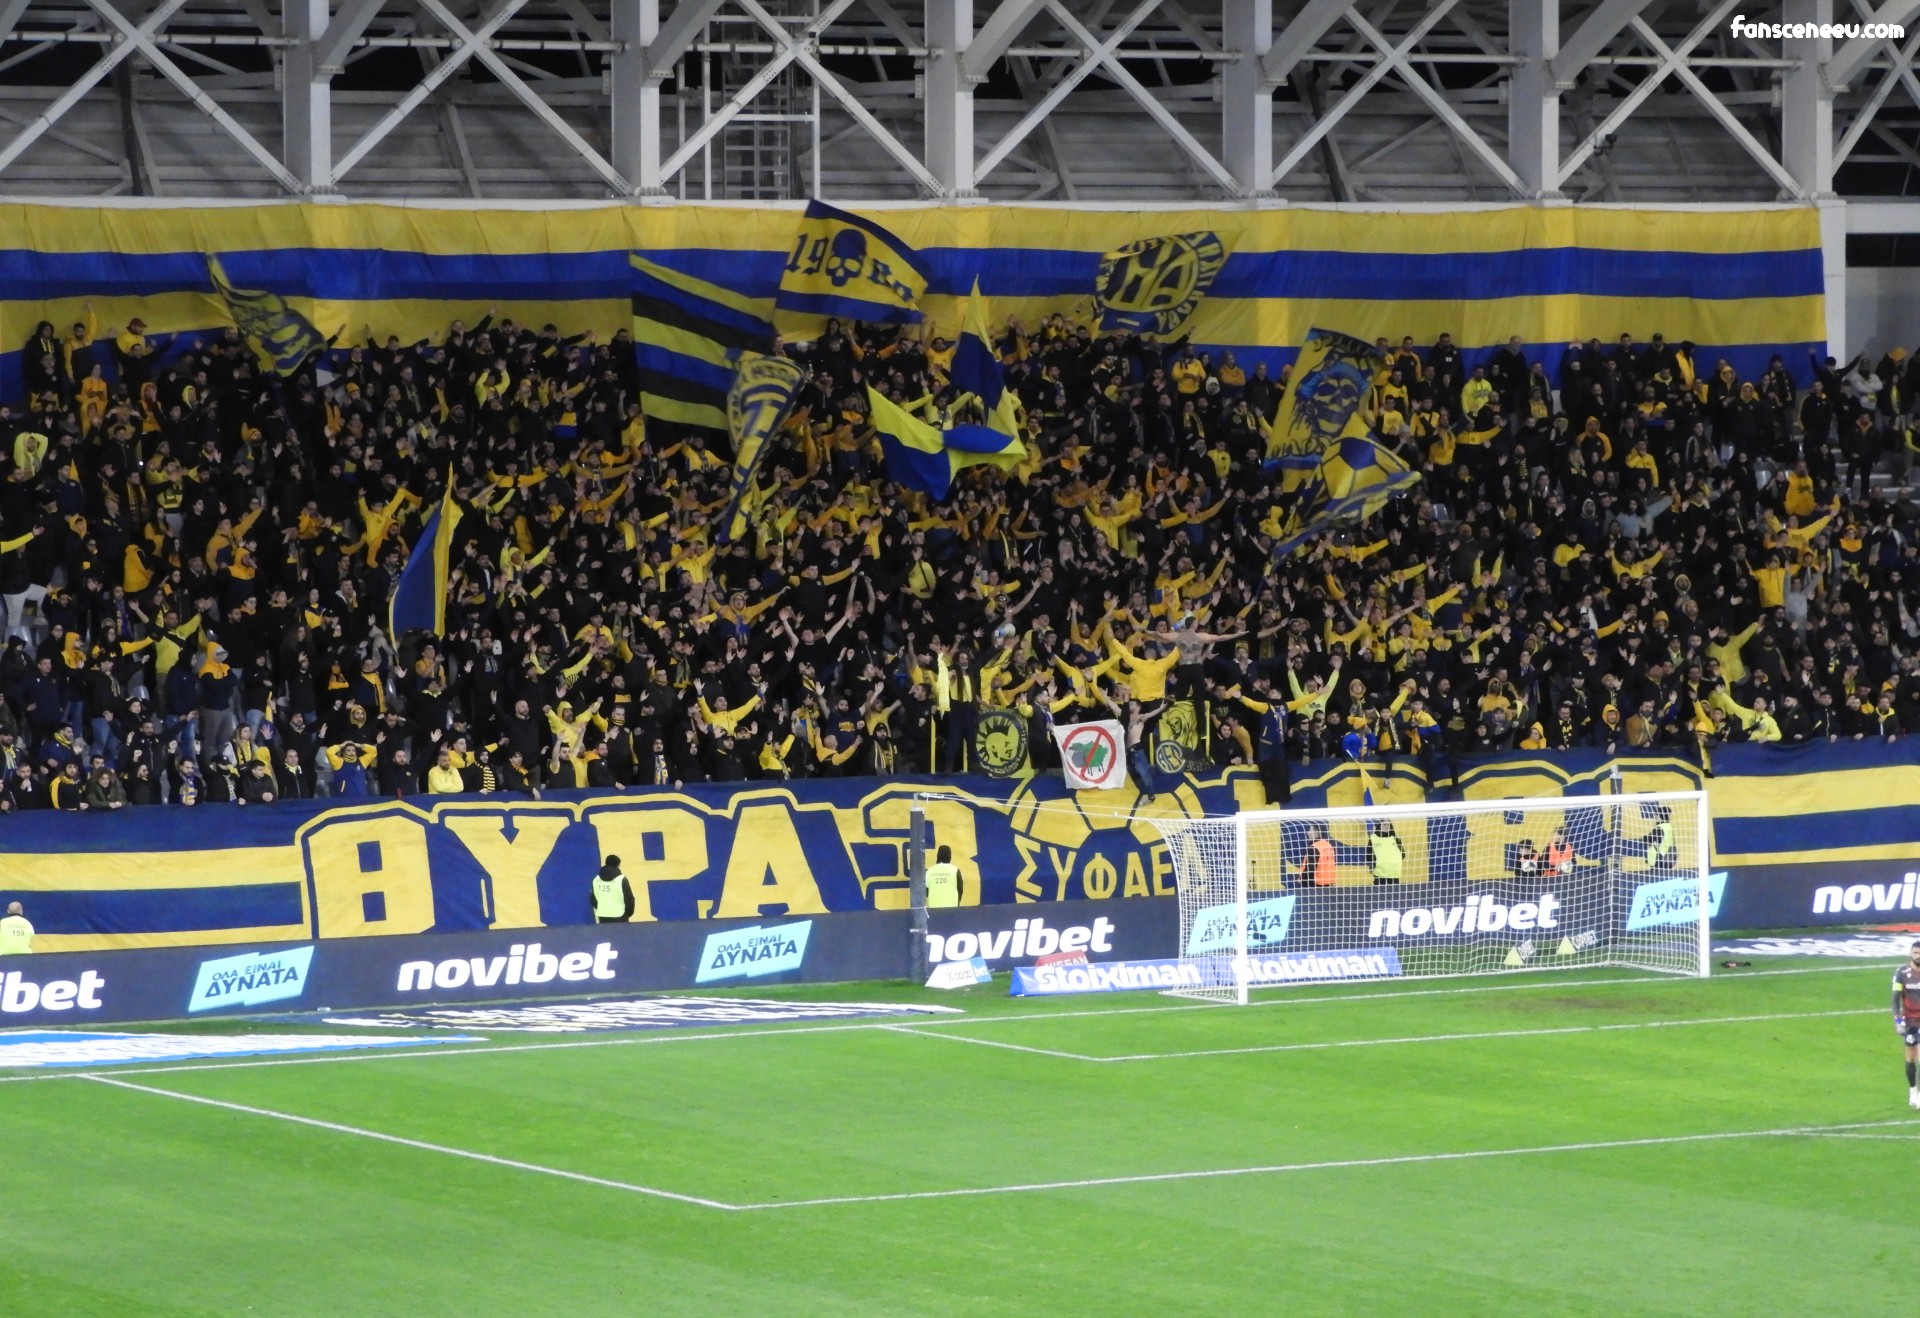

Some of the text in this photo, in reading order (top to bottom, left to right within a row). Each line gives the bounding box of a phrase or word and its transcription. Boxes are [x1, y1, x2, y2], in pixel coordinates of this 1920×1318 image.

[1812, 872, 1920, 914] novi
[1368, 893, 1560, 938] novibet
[397, 942, 619, 991] novibet
[710, 940, 808, 970] ΔΥΝΑΤΑ
[204, 966, 299, 998] ΔΥΝΑΤΑ
[1034, 962, 1203, 991] Stoiximan
